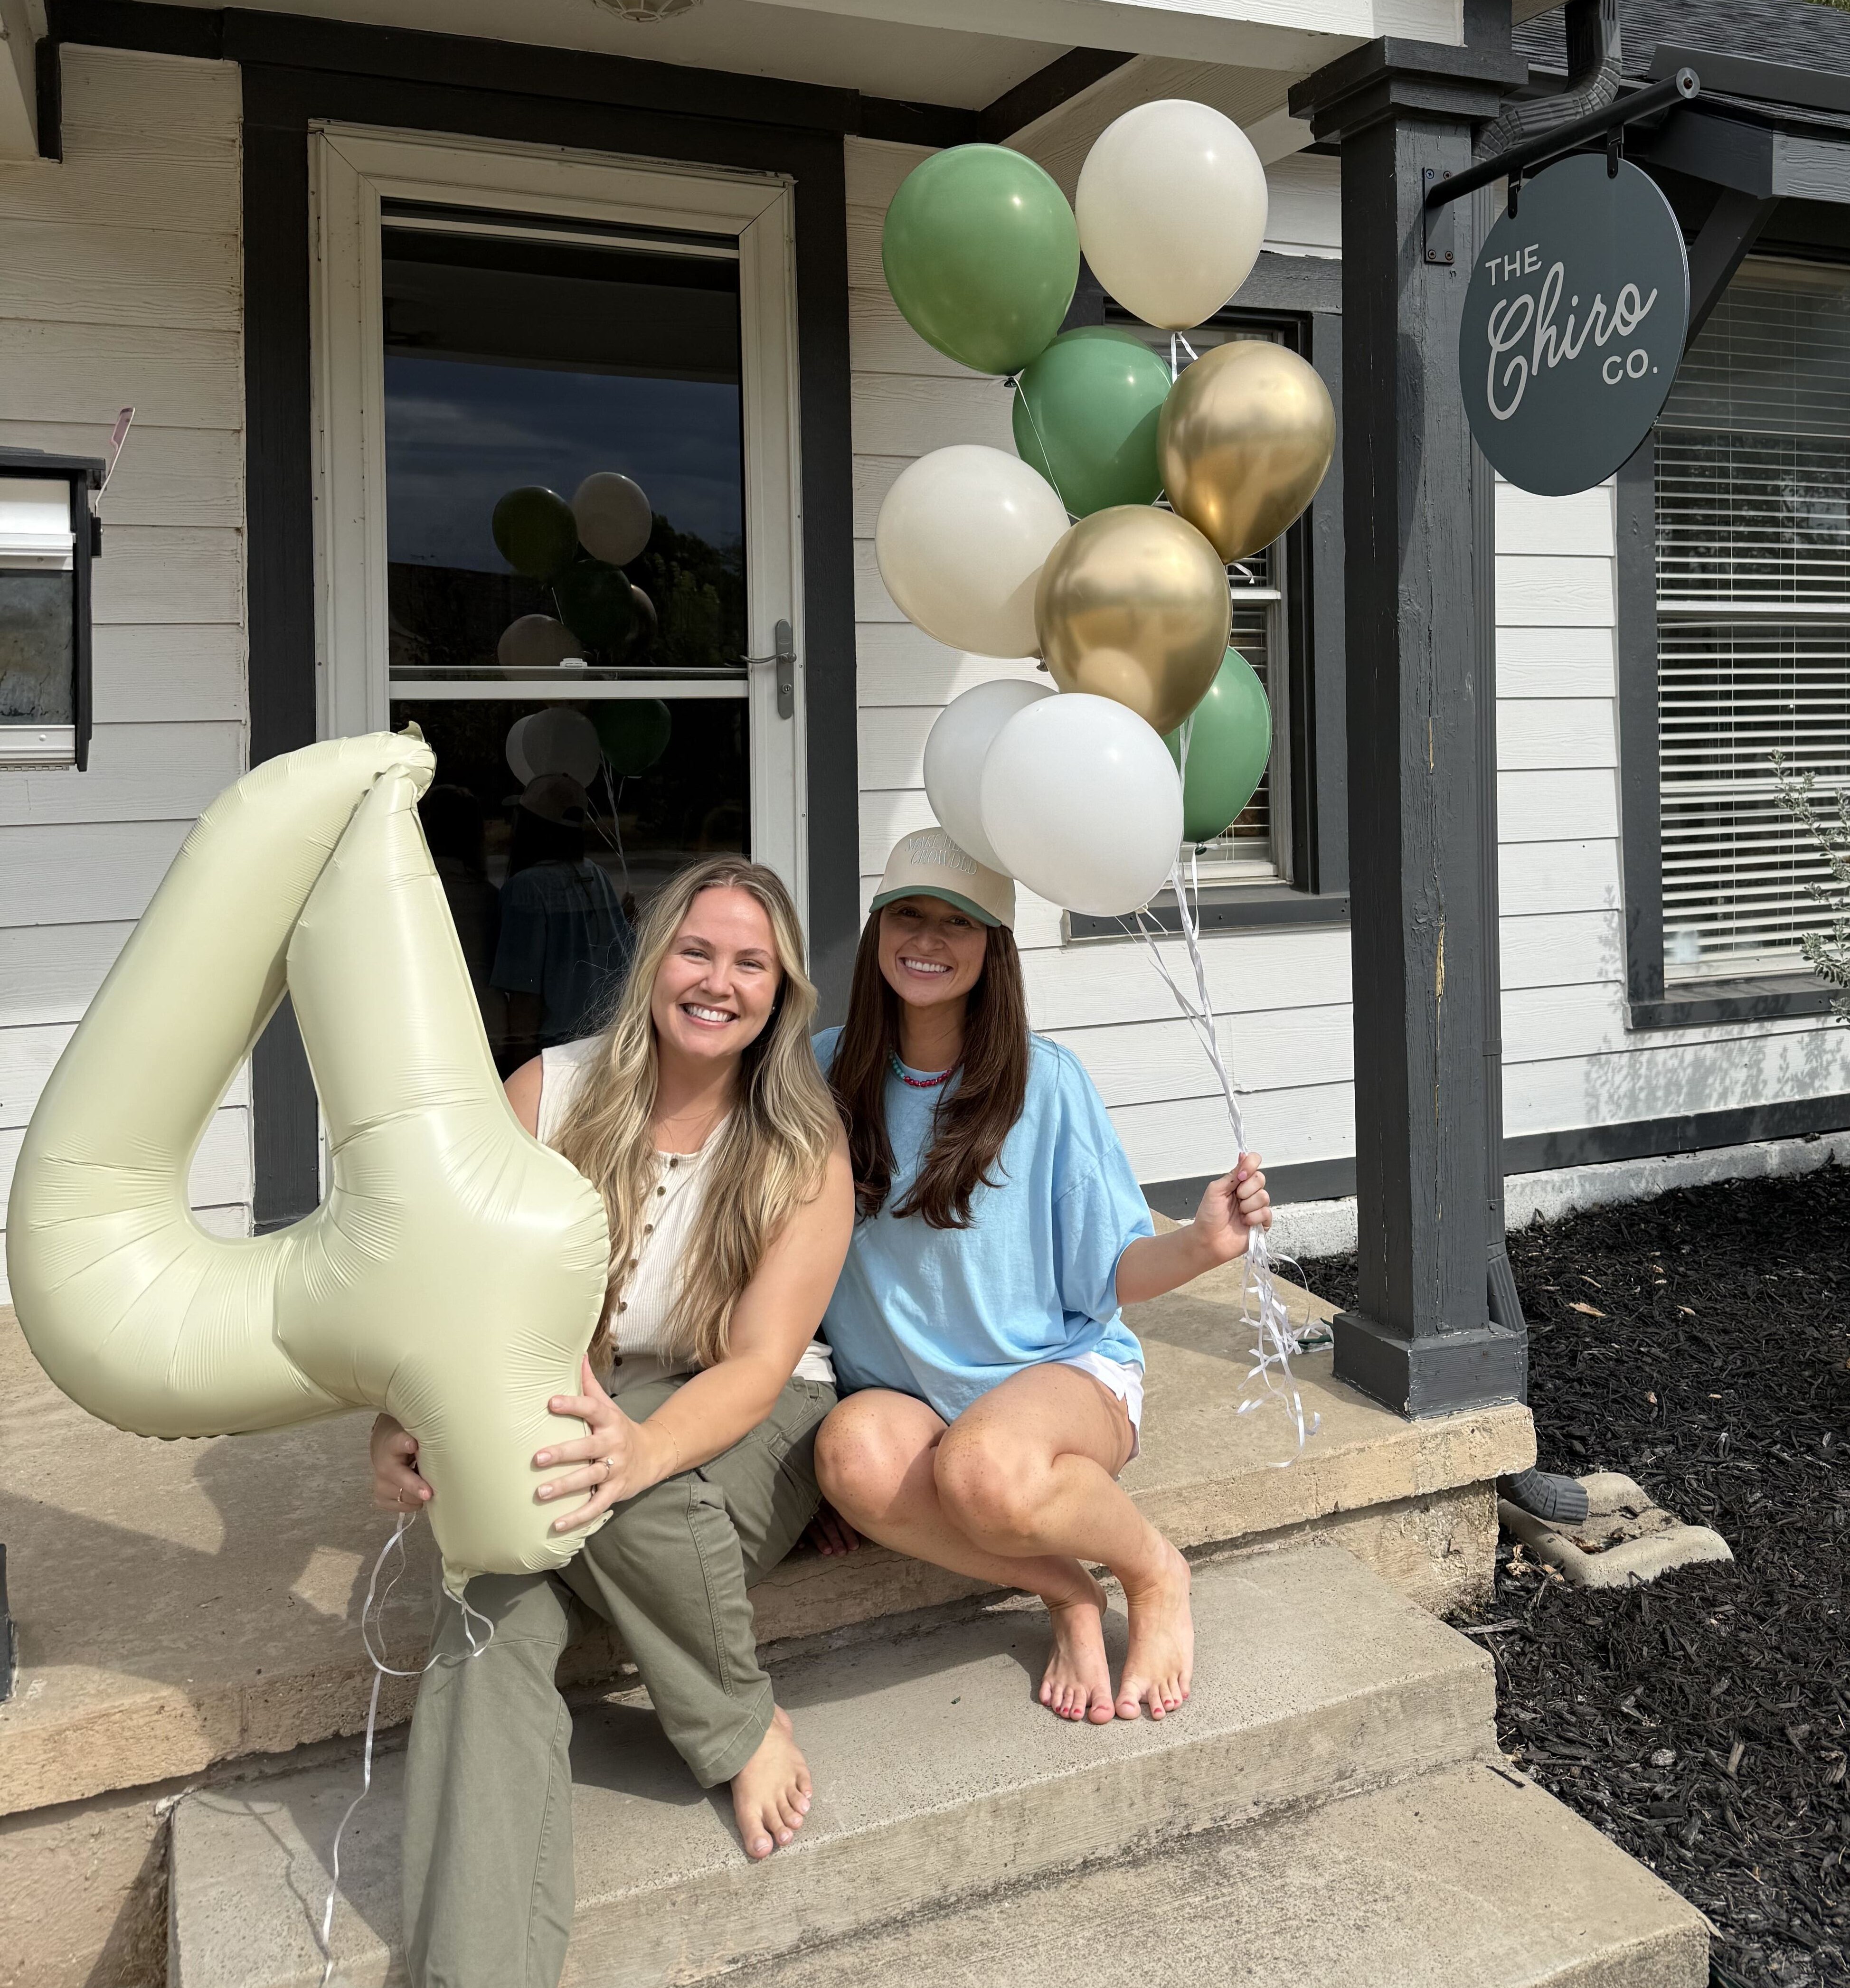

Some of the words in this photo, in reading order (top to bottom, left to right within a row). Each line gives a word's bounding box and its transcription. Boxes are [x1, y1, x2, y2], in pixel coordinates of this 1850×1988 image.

[1485, 244, 1542, 286] THE
[1487, 262, 1658, 420] Chiro
[1602, 349, 1658, 385] CO.
